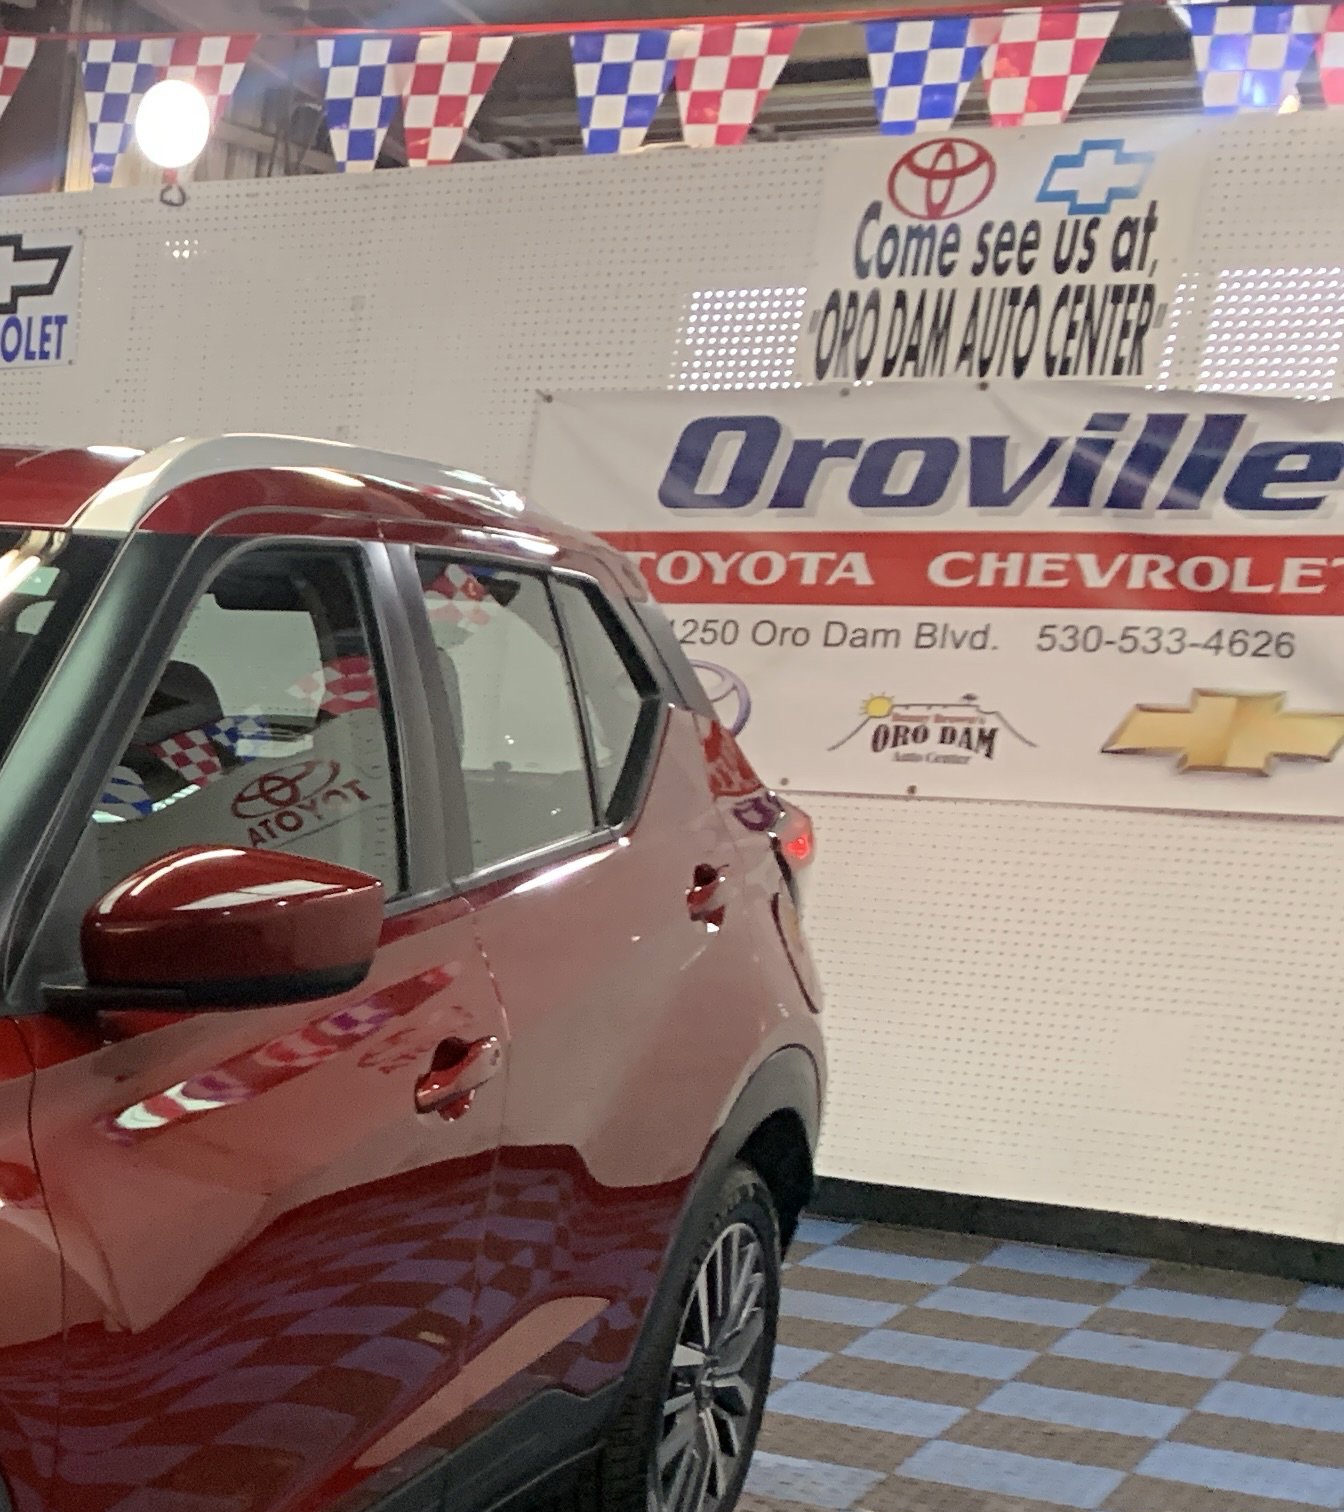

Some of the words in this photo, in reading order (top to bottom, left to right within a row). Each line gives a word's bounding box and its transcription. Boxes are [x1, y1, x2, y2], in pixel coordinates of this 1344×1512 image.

[854, 200, 962, 280] Come
[971, 219, 1042, 277] see
[1054, 216, 1102, 275] us
[1111, 200, 1159, 278] at,
[881, 288, 956, 378] DAM
[956, 284, 1042, 379] AUTO
[1044, 283, 1169, 379] CENTER"
[658, 412, 1344, 511] Oroville
[926, 551, 1344, 595] CHEVROLE
[670, 618, 739, 645] 250
[752, 619, 809, 646] Oro
[823, 622, 901, 649] Dam
[914, 622, 1000, 652] Blvd.
[1036, 625, 1297, 659] 530-533-4626
[871, 723, 929, 753] ORO
[939, 726, 999, 760] DAM
